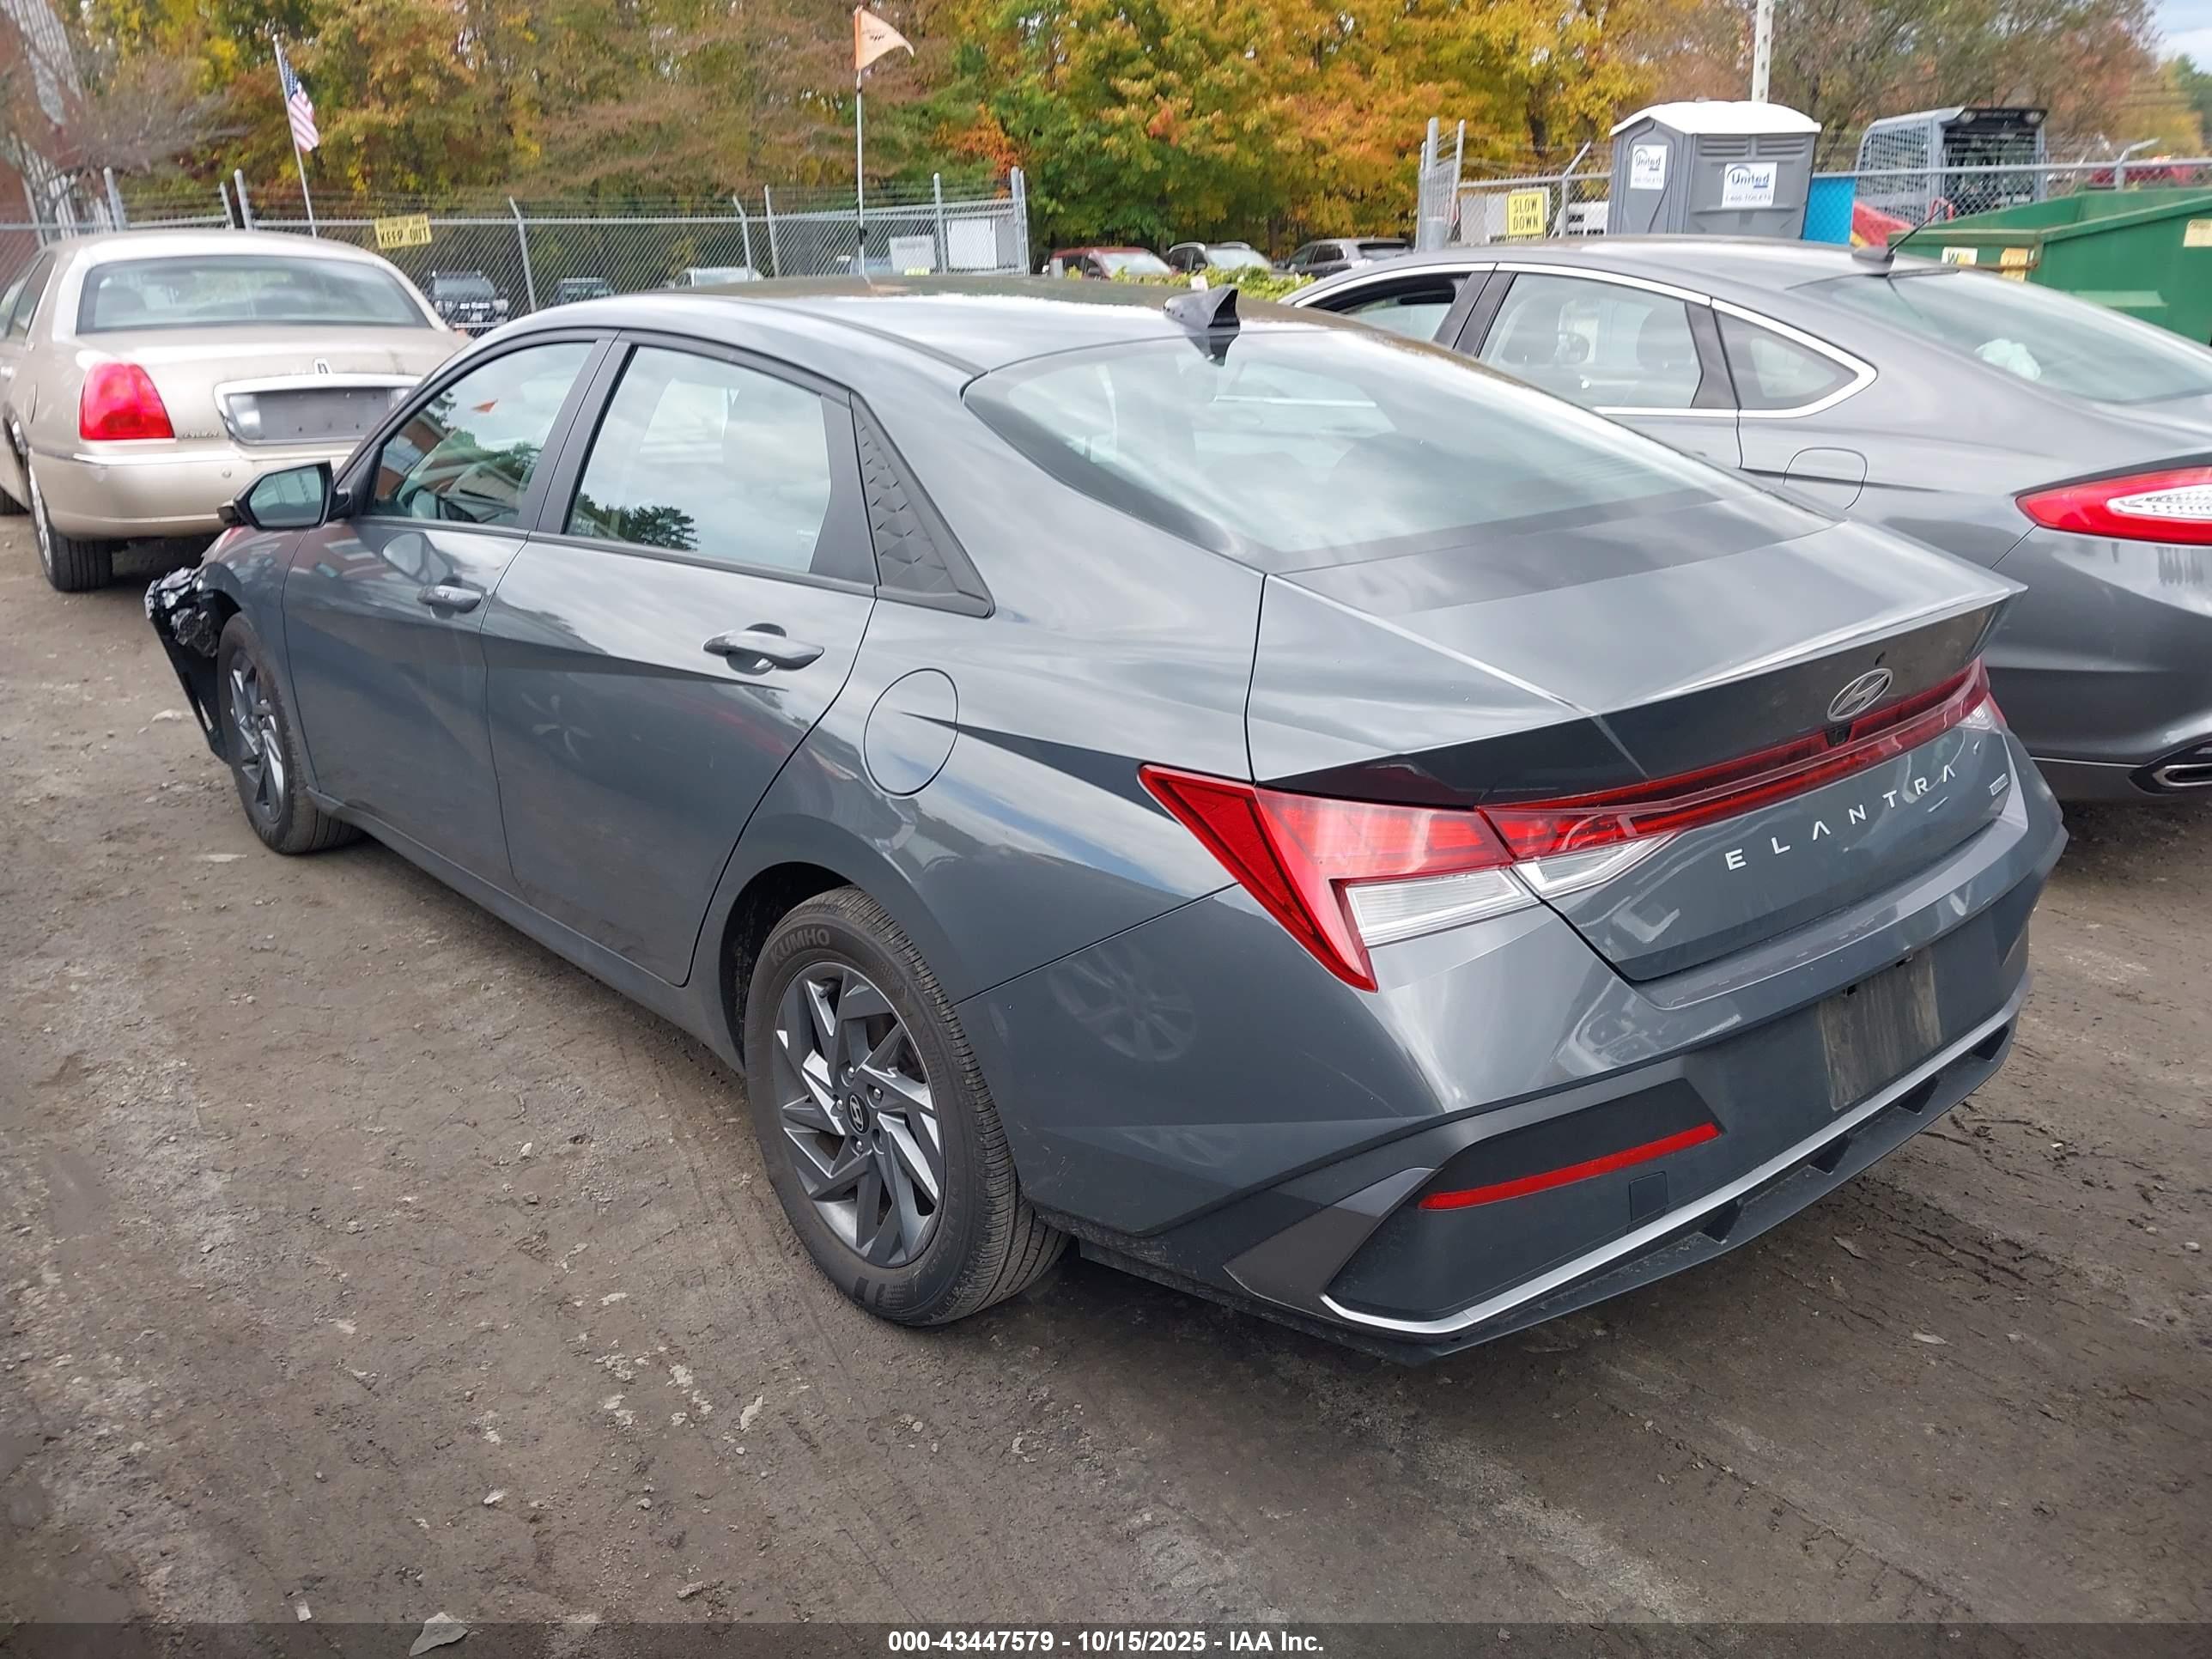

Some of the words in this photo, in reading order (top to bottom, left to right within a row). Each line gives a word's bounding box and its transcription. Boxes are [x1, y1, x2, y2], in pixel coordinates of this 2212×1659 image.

[1731, 172, 1770, 185] United
[1514, 198, 1538, 213] SLOW
[1513, 215, 1538, 230] DOWN
[380, 229, 403, 244] KEEP
[410, 227, 427, 241] OUT
[1725, 764, 1955, 871] ELANTRA
[771, 927, 830, 966] KUMHO
